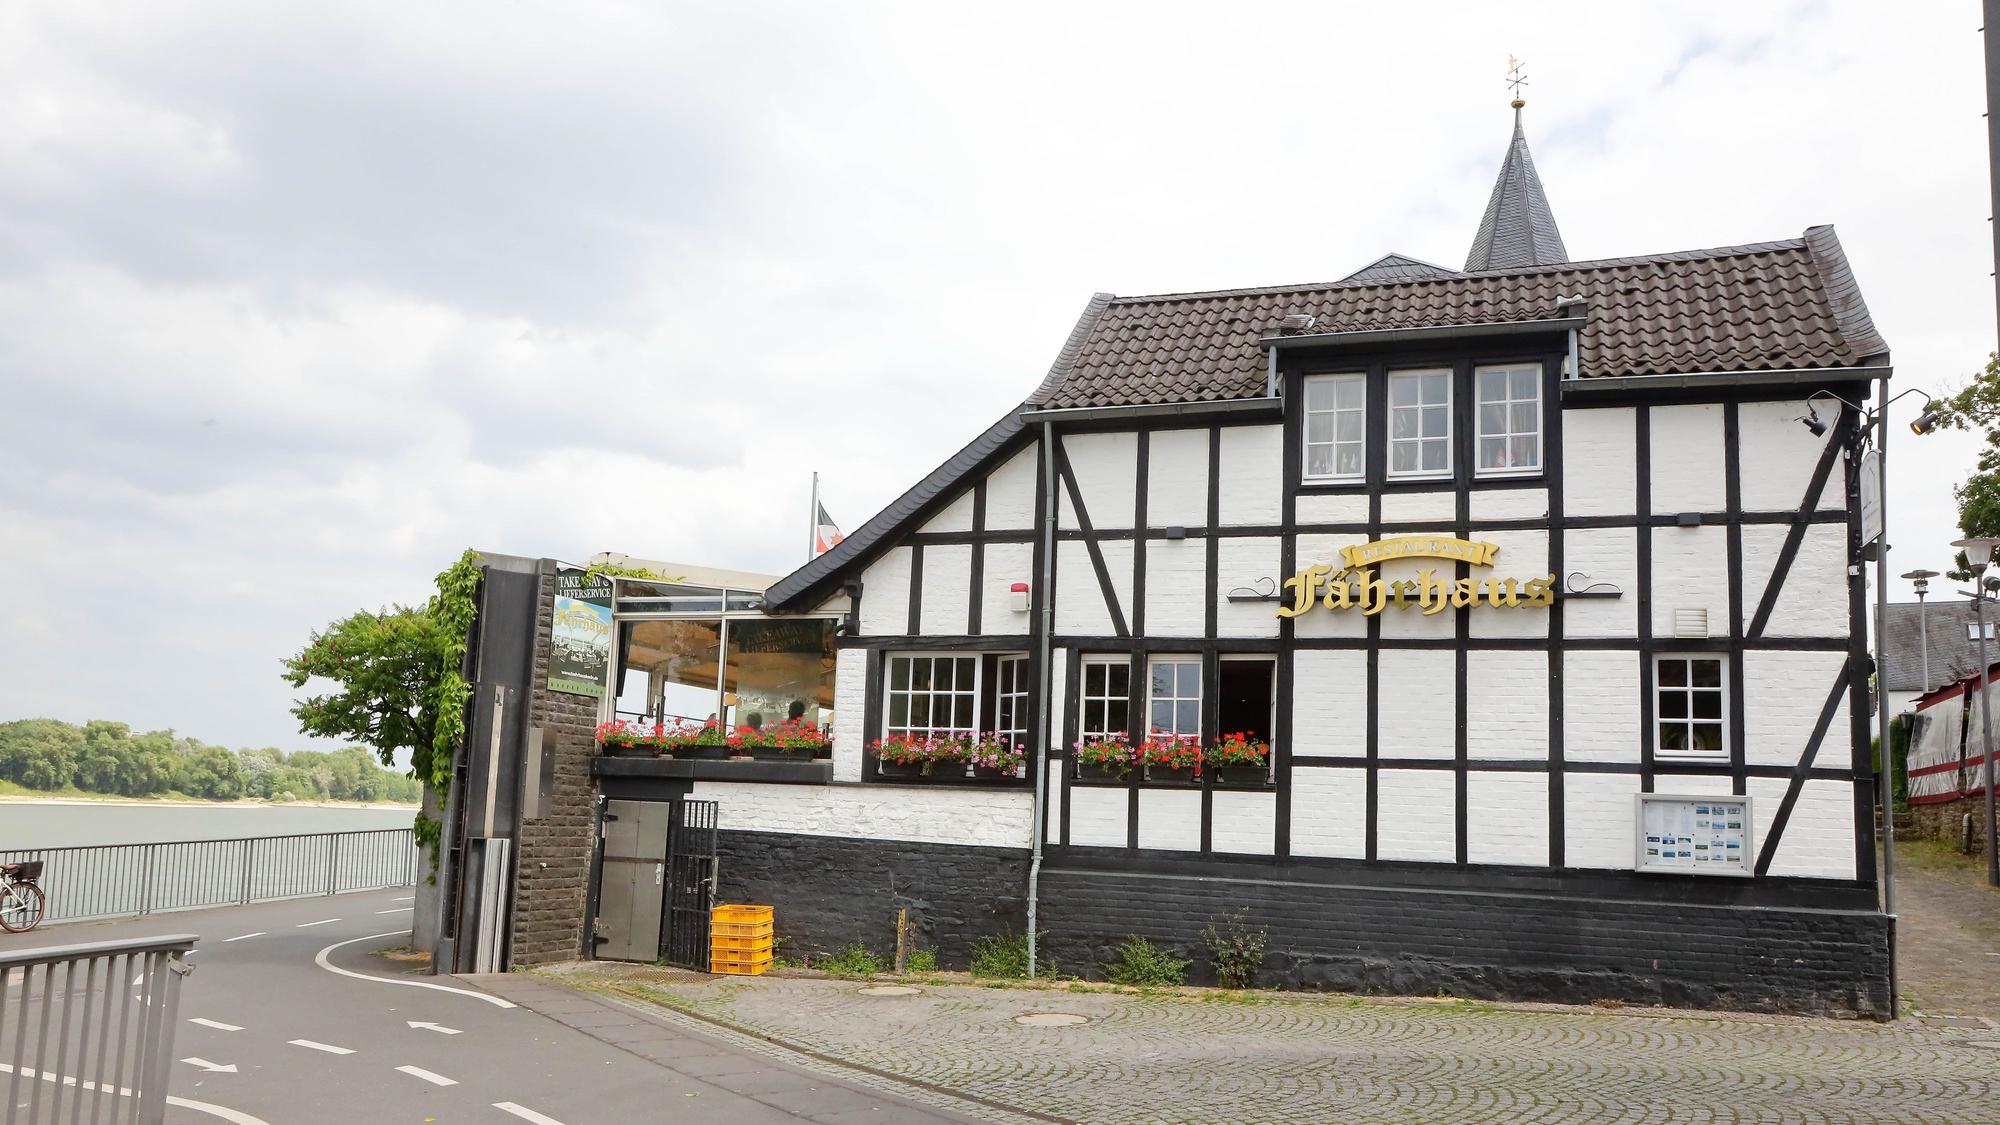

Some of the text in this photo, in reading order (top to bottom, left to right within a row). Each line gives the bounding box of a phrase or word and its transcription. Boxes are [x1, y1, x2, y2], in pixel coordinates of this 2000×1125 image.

[1362, 541, 1477, 561] RESTAURANT
[559, 588, 611, 599] LIEFERSERVICE
[1275, 563, 1556, 619] Fährhaus
